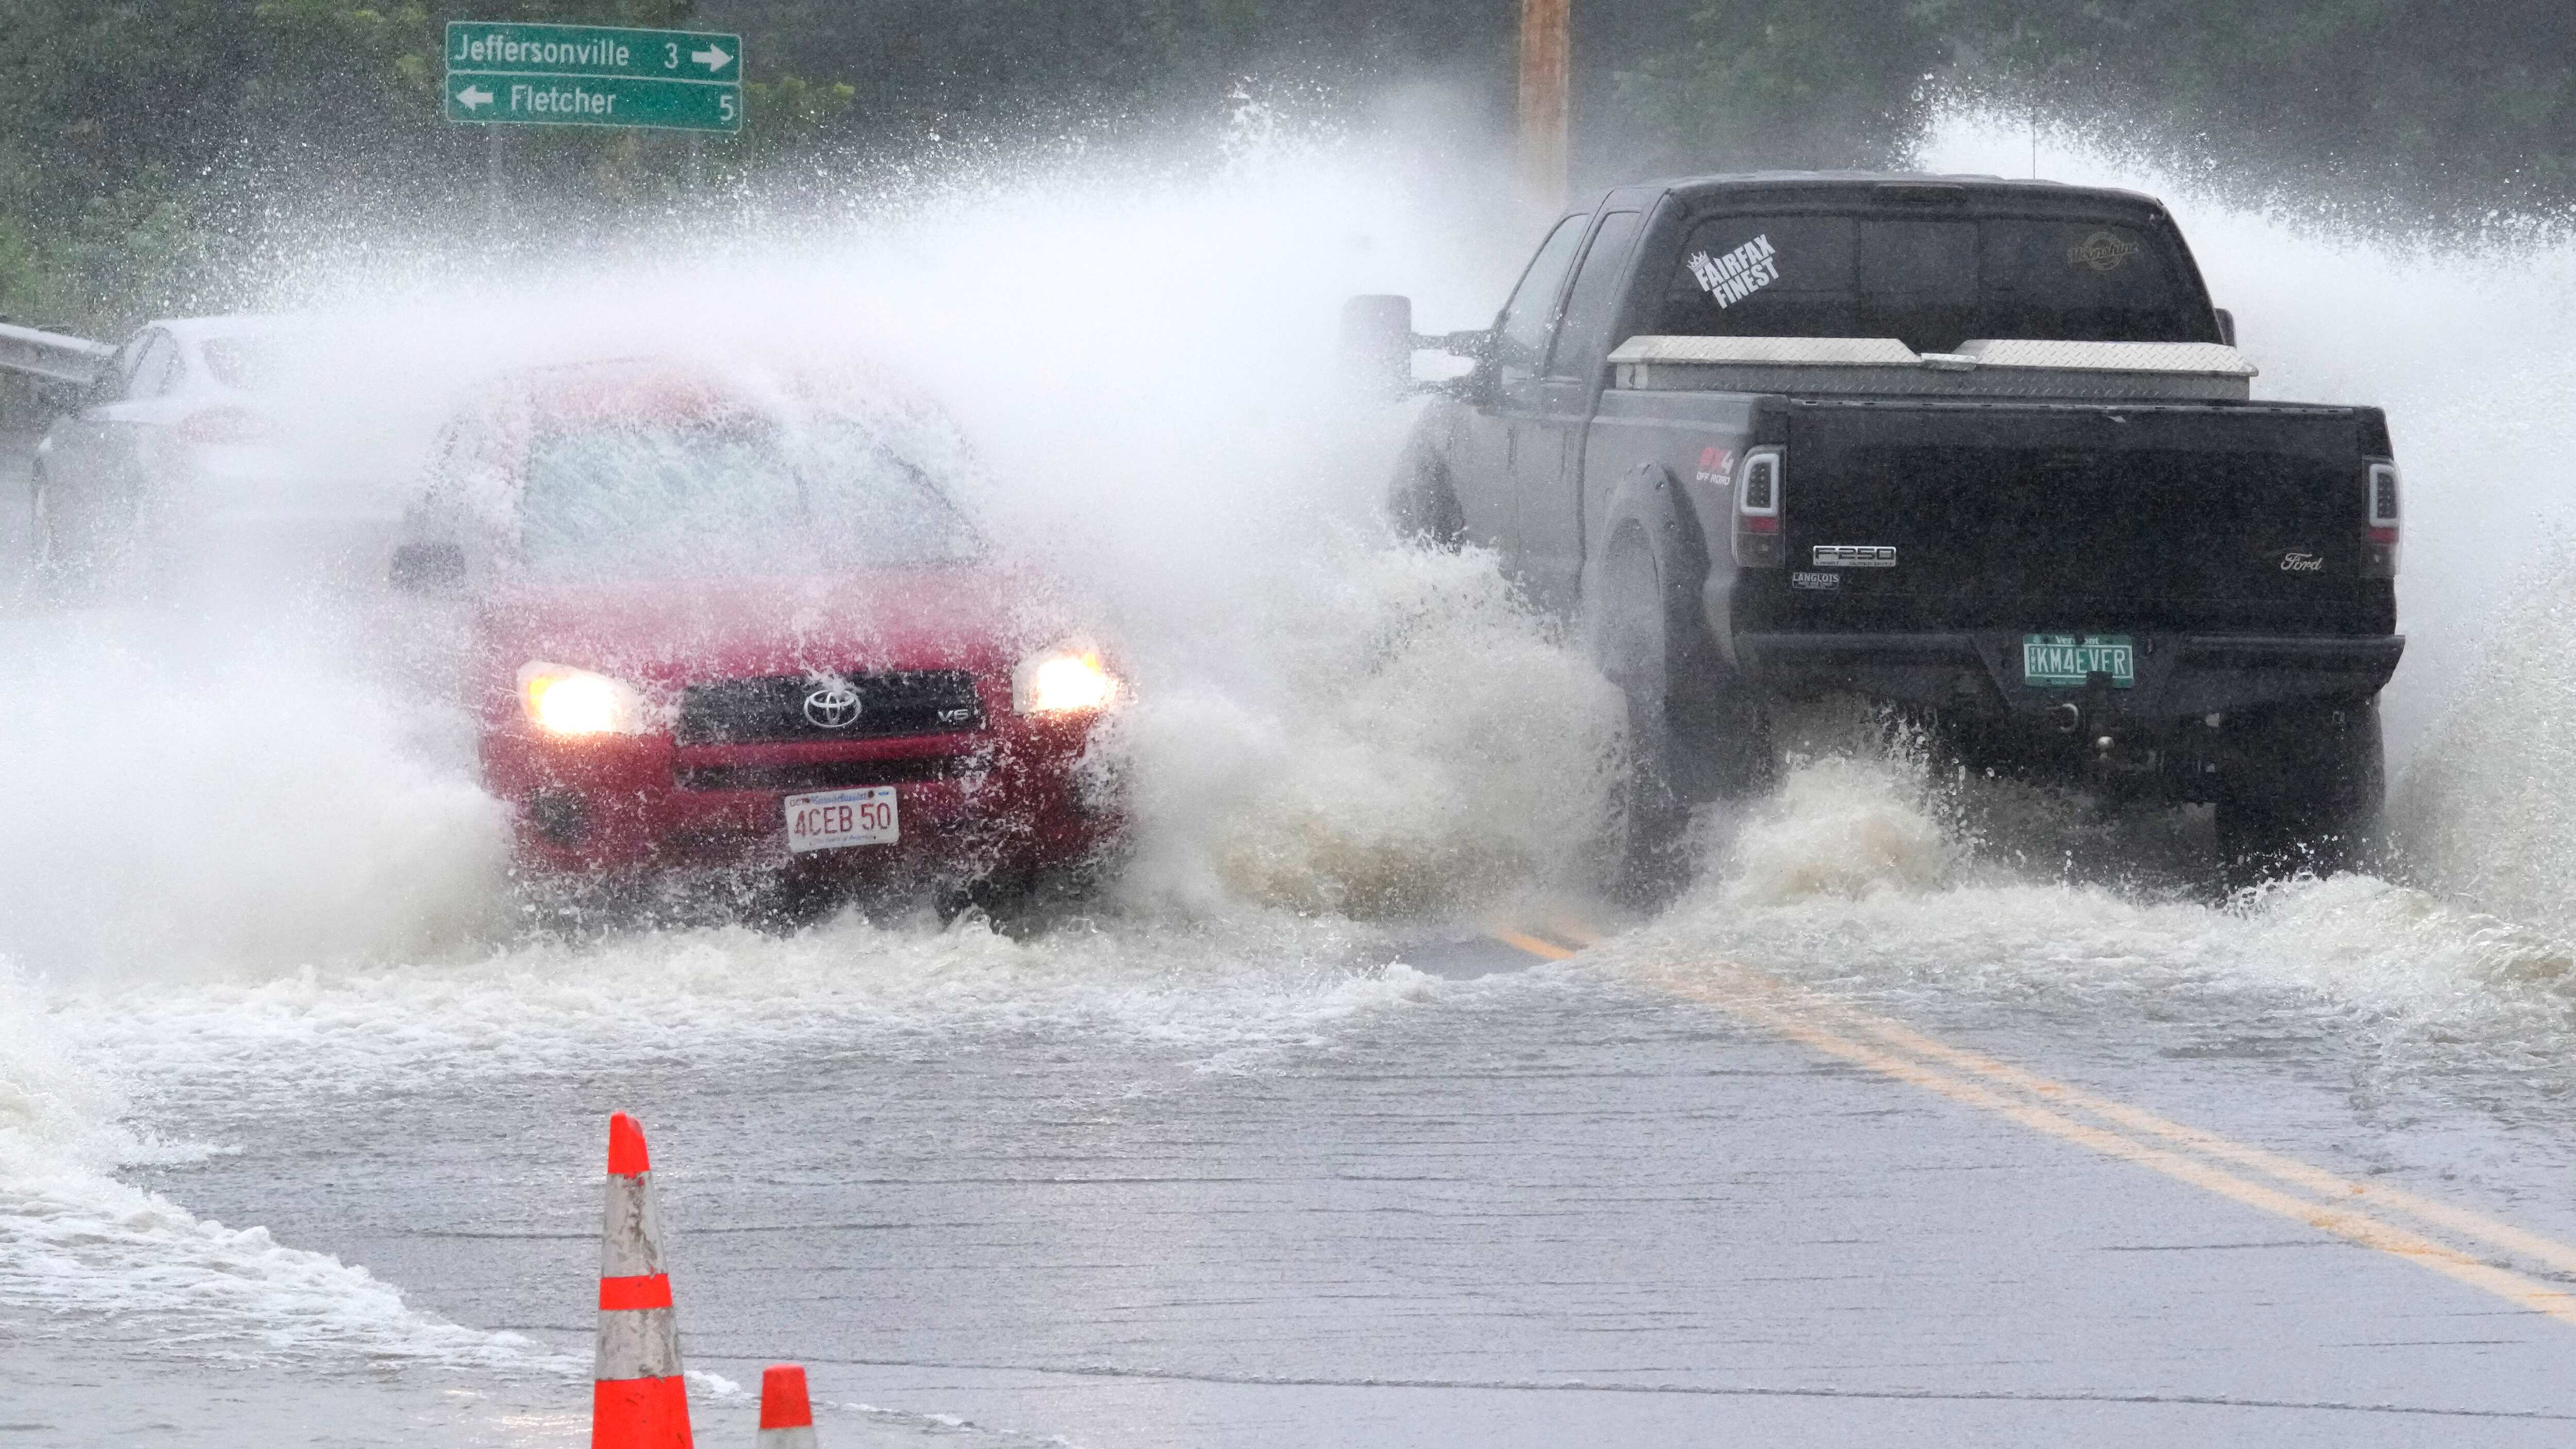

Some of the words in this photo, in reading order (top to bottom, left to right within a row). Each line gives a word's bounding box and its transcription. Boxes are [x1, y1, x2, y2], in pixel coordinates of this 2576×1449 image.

[454, 34, 630, 66] Jeffersonville
[664, 43, 679, 69] 3
[511, 85, 616, 114] Fletcher
[720, 95, 734, 121] 5
[1695, 233, 1776, 292] FAIRFAX
[1713, 257, 1779, 310] FINEST
[2281, 553, 2323, 570] Ford
[1793, 573, 1839, 583] LANGLOIS
[2055, 635, 2099, 645] Veront
[2037, 647, 2126, 675] KM4EVER
[938, 709, 969, 722] V6
[794, 805, 853, 838] 4CEB
[861, 802, 891, 830] 50
